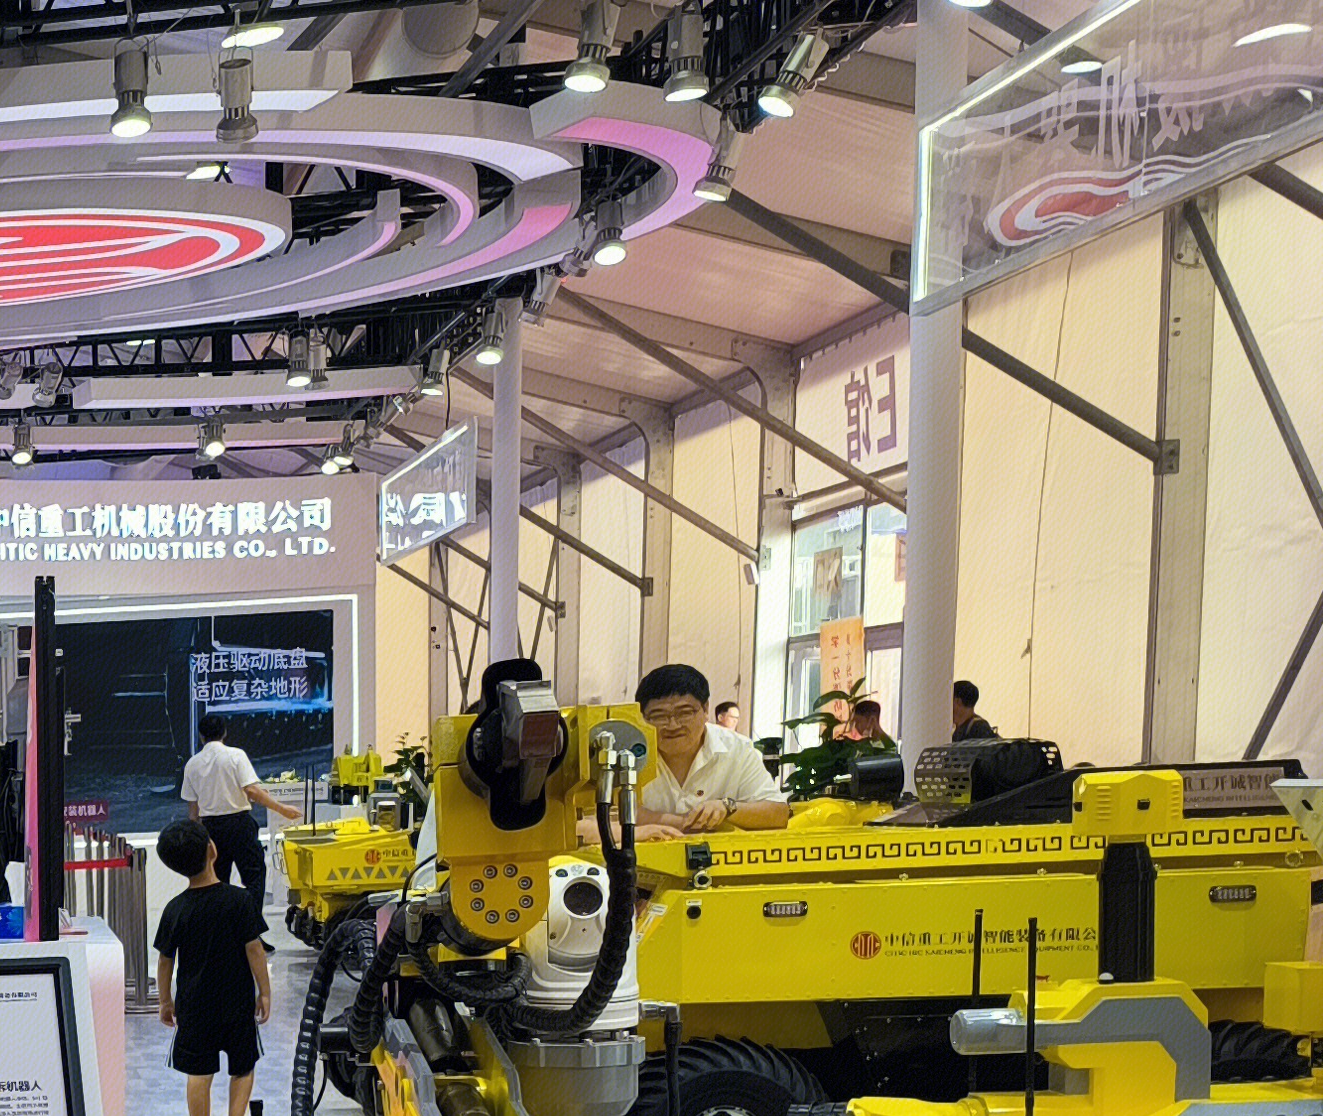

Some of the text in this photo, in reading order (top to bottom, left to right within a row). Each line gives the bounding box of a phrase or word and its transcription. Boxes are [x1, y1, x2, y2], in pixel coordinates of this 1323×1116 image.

[44, 542, 105, 561] HEAVY
[110, 540, 227, 561] INDUSTRIES
[284, 536, 337, 557] LTD.
[192, 648, 308, 673] 液压驱动底盘
[192, 677, 309, 701] 适应复杂地形
